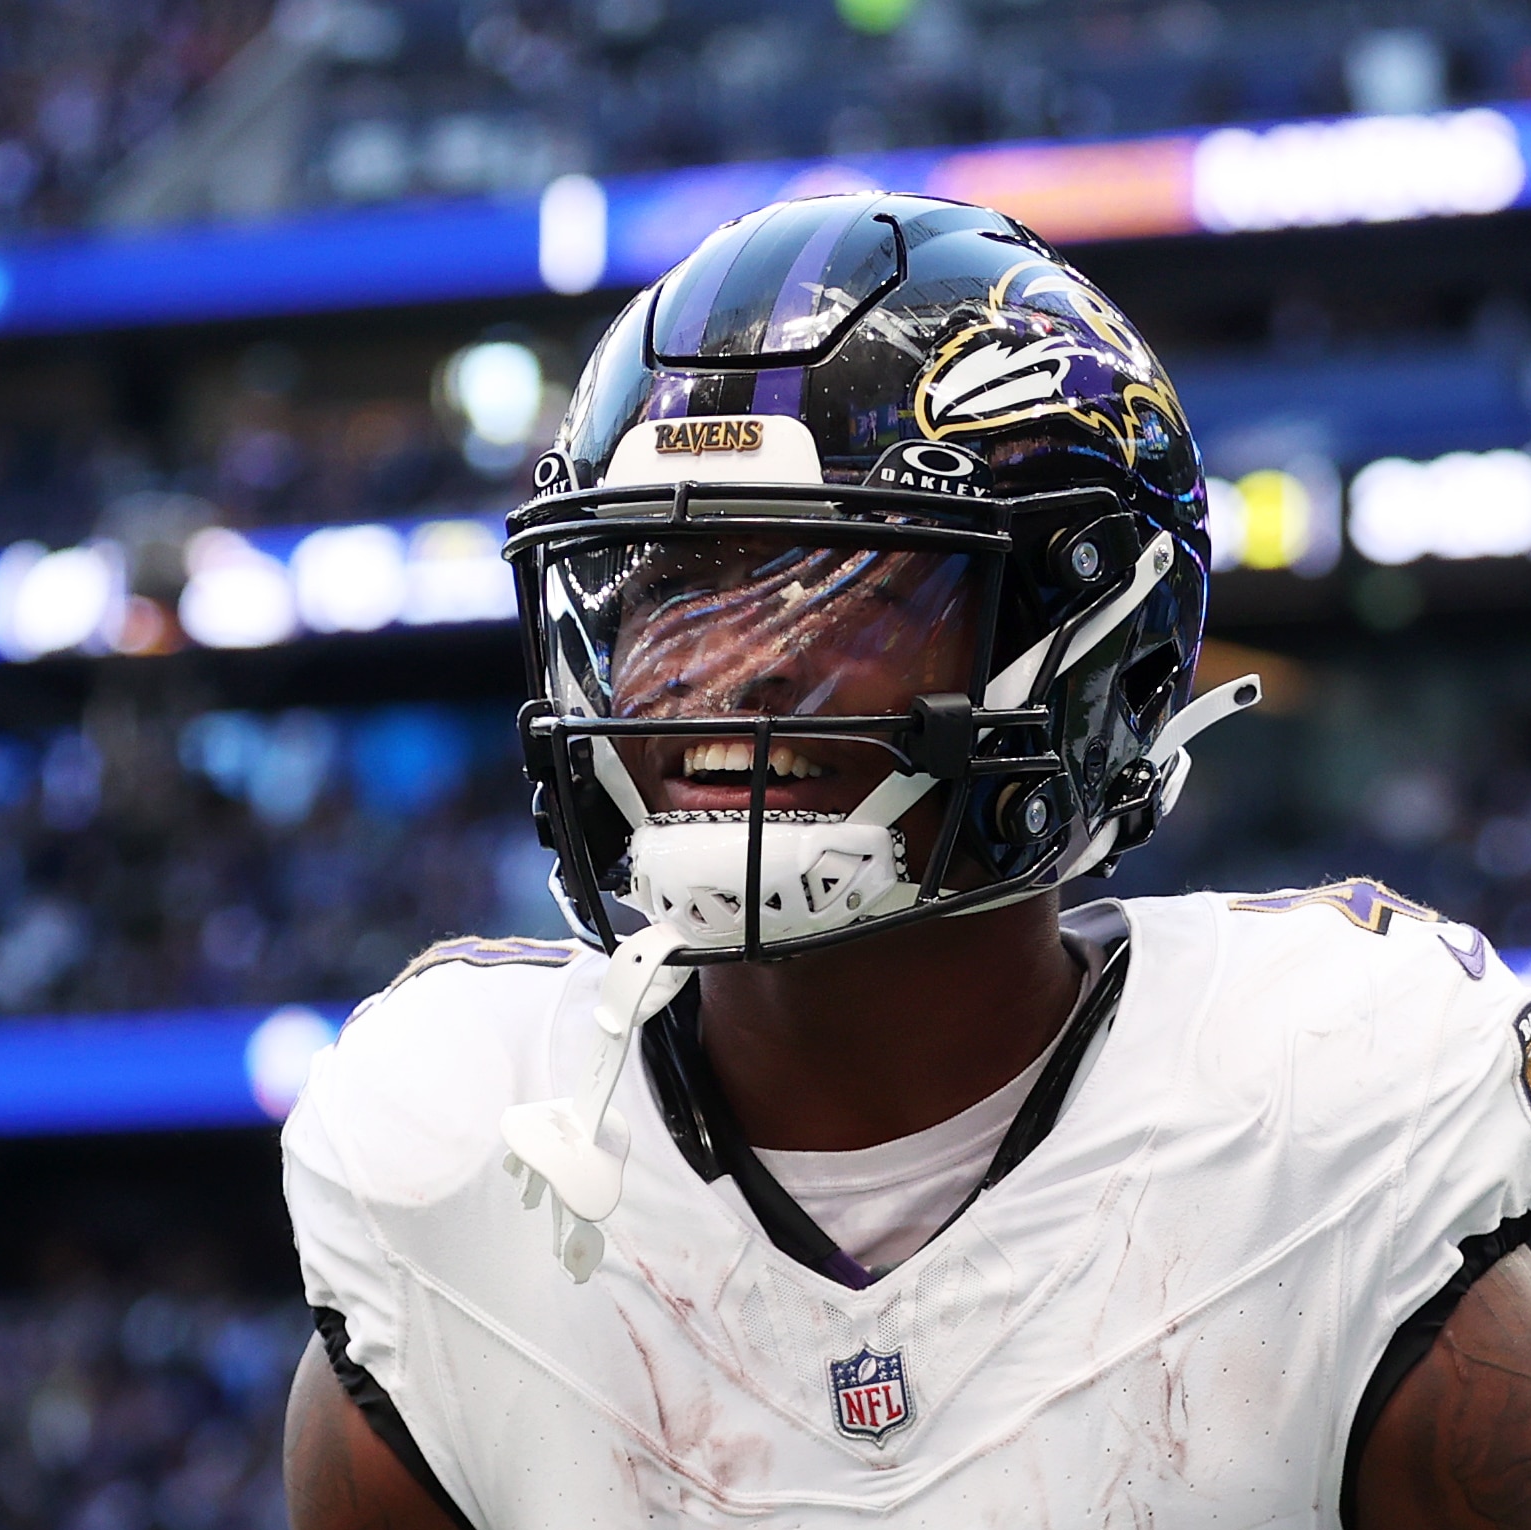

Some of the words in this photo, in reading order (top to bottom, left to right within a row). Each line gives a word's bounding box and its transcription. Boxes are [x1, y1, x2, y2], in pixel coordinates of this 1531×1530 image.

[655, 420, 764, 456] RAVENS
[880, 467, 987, 498] OAKLEY
[842, 1384, 903, 1428] NFL
